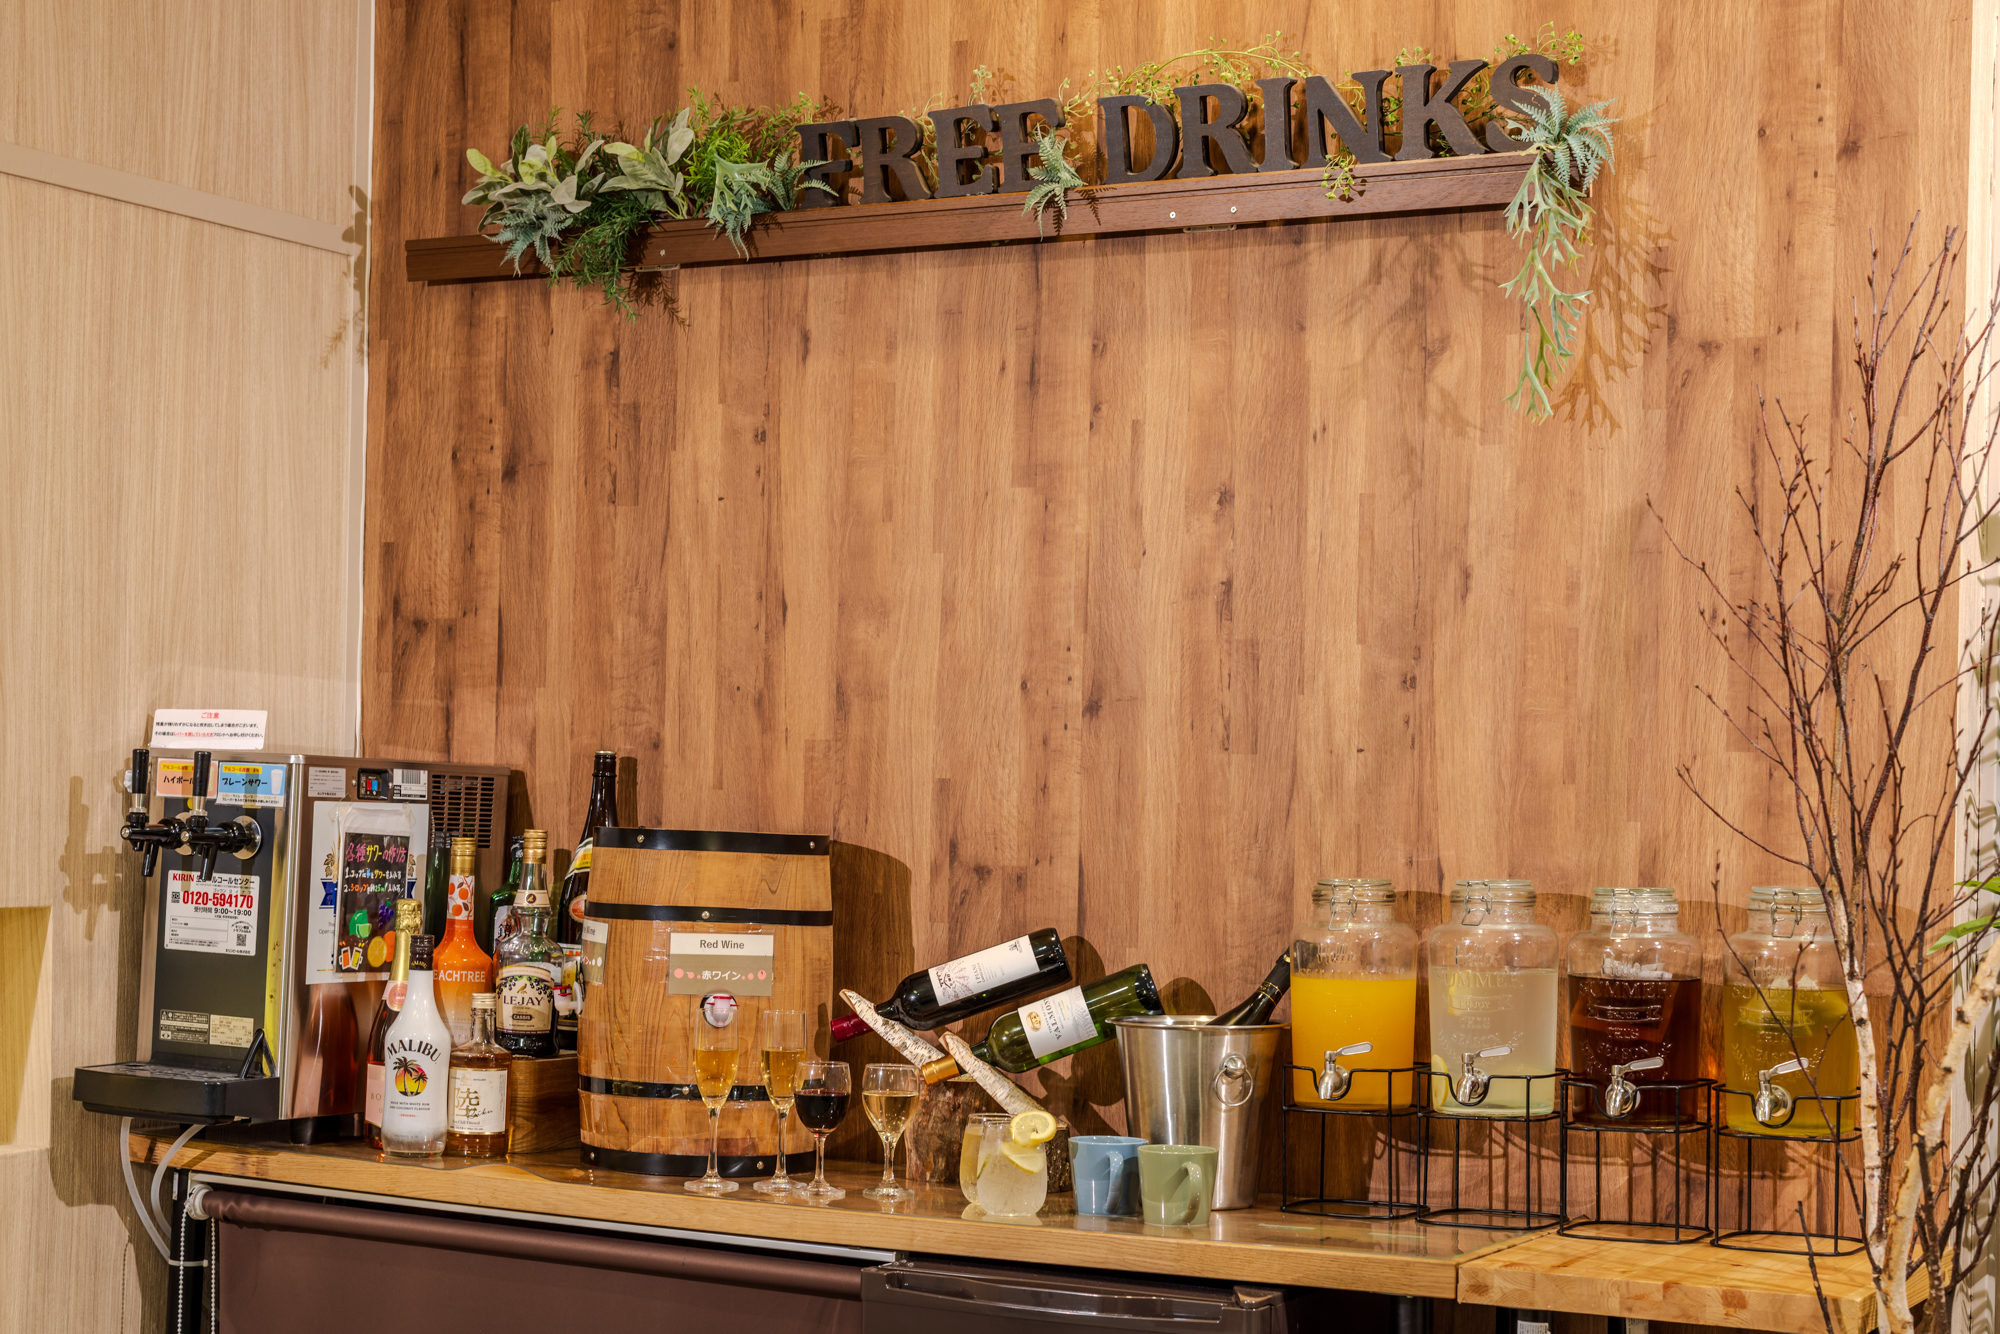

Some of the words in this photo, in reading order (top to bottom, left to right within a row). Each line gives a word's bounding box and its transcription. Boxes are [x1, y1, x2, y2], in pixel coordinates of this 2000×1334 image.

[795, 97, 1066, 209] FREE
[1096, 53, 1560, 185] DRINKS
[201, 711, 220, 719] ご注意
[222, 778, 268, 787] プレーンサワー
[172, 873, 195, 882] KIRIN
[196, 875, 255, 886] 生ルコールセンター
[182, 890, 254, 909] 0120-594170
[194, 906, 213, 914] 受付時間
[699, 939, 719, 949] Red
[721, 940, 745, 949] Wine
[433, 970, 486, 982] EACHTREE
[701, 970, 741, 981] 赤ワイン
[1435, 970, 1523, 988] SUMMER
[503, 995, 543, 1006] LEJAY
[387, 1039, 442, 1062] MALIBU
